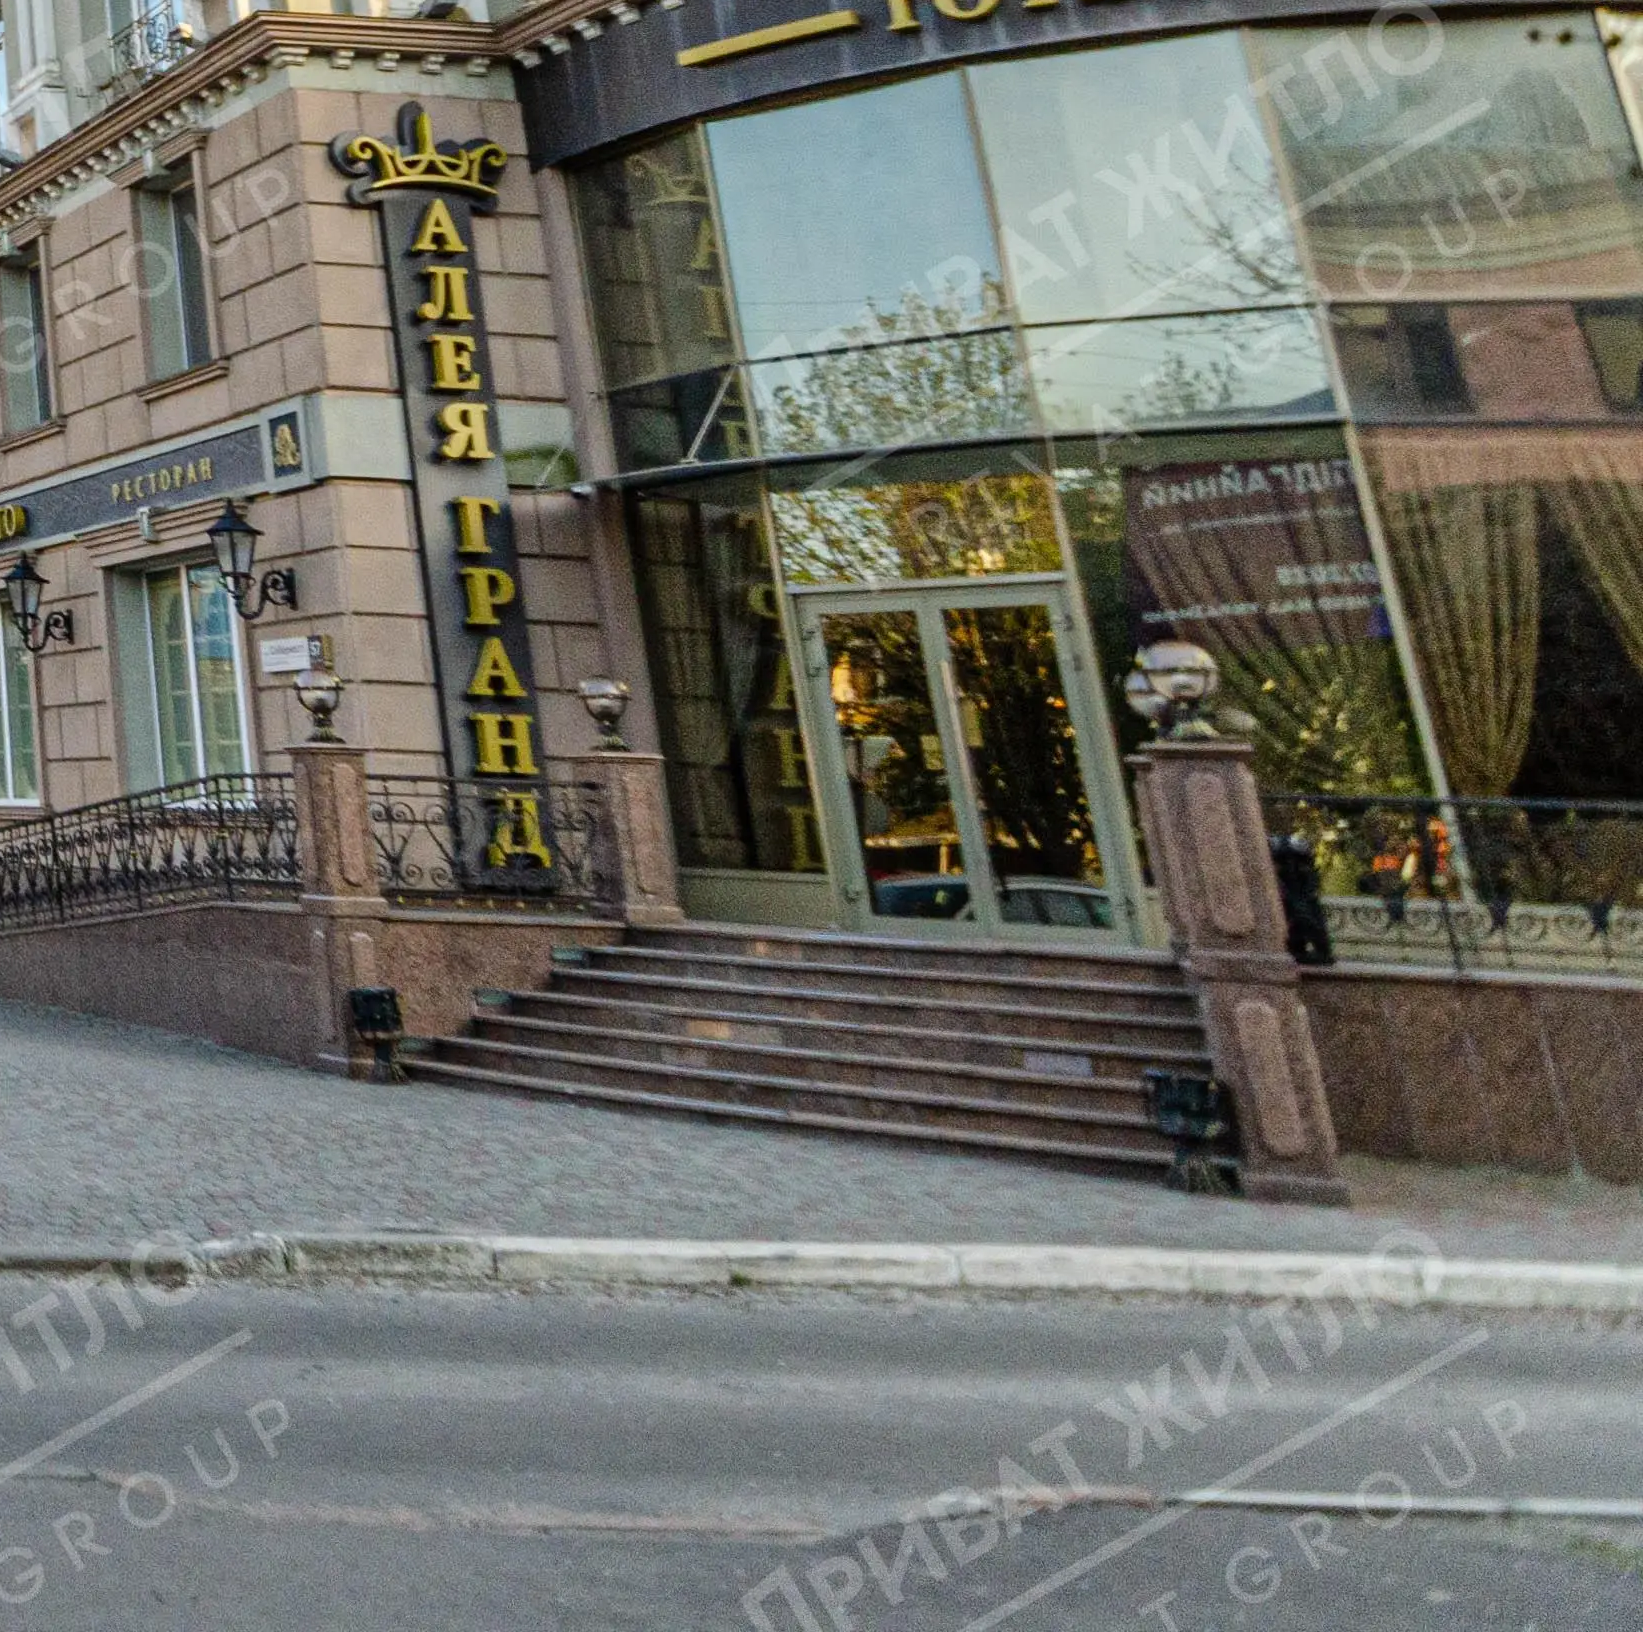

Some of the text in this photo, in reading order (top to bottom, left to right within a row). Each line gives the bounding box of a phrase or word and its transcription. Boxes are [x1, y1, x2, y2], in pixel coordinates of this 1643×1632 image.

[111, 456, 213, 503] РЕСТОРАН
[411, 198, 553, 869] АЛЕЯ ГРАНД
